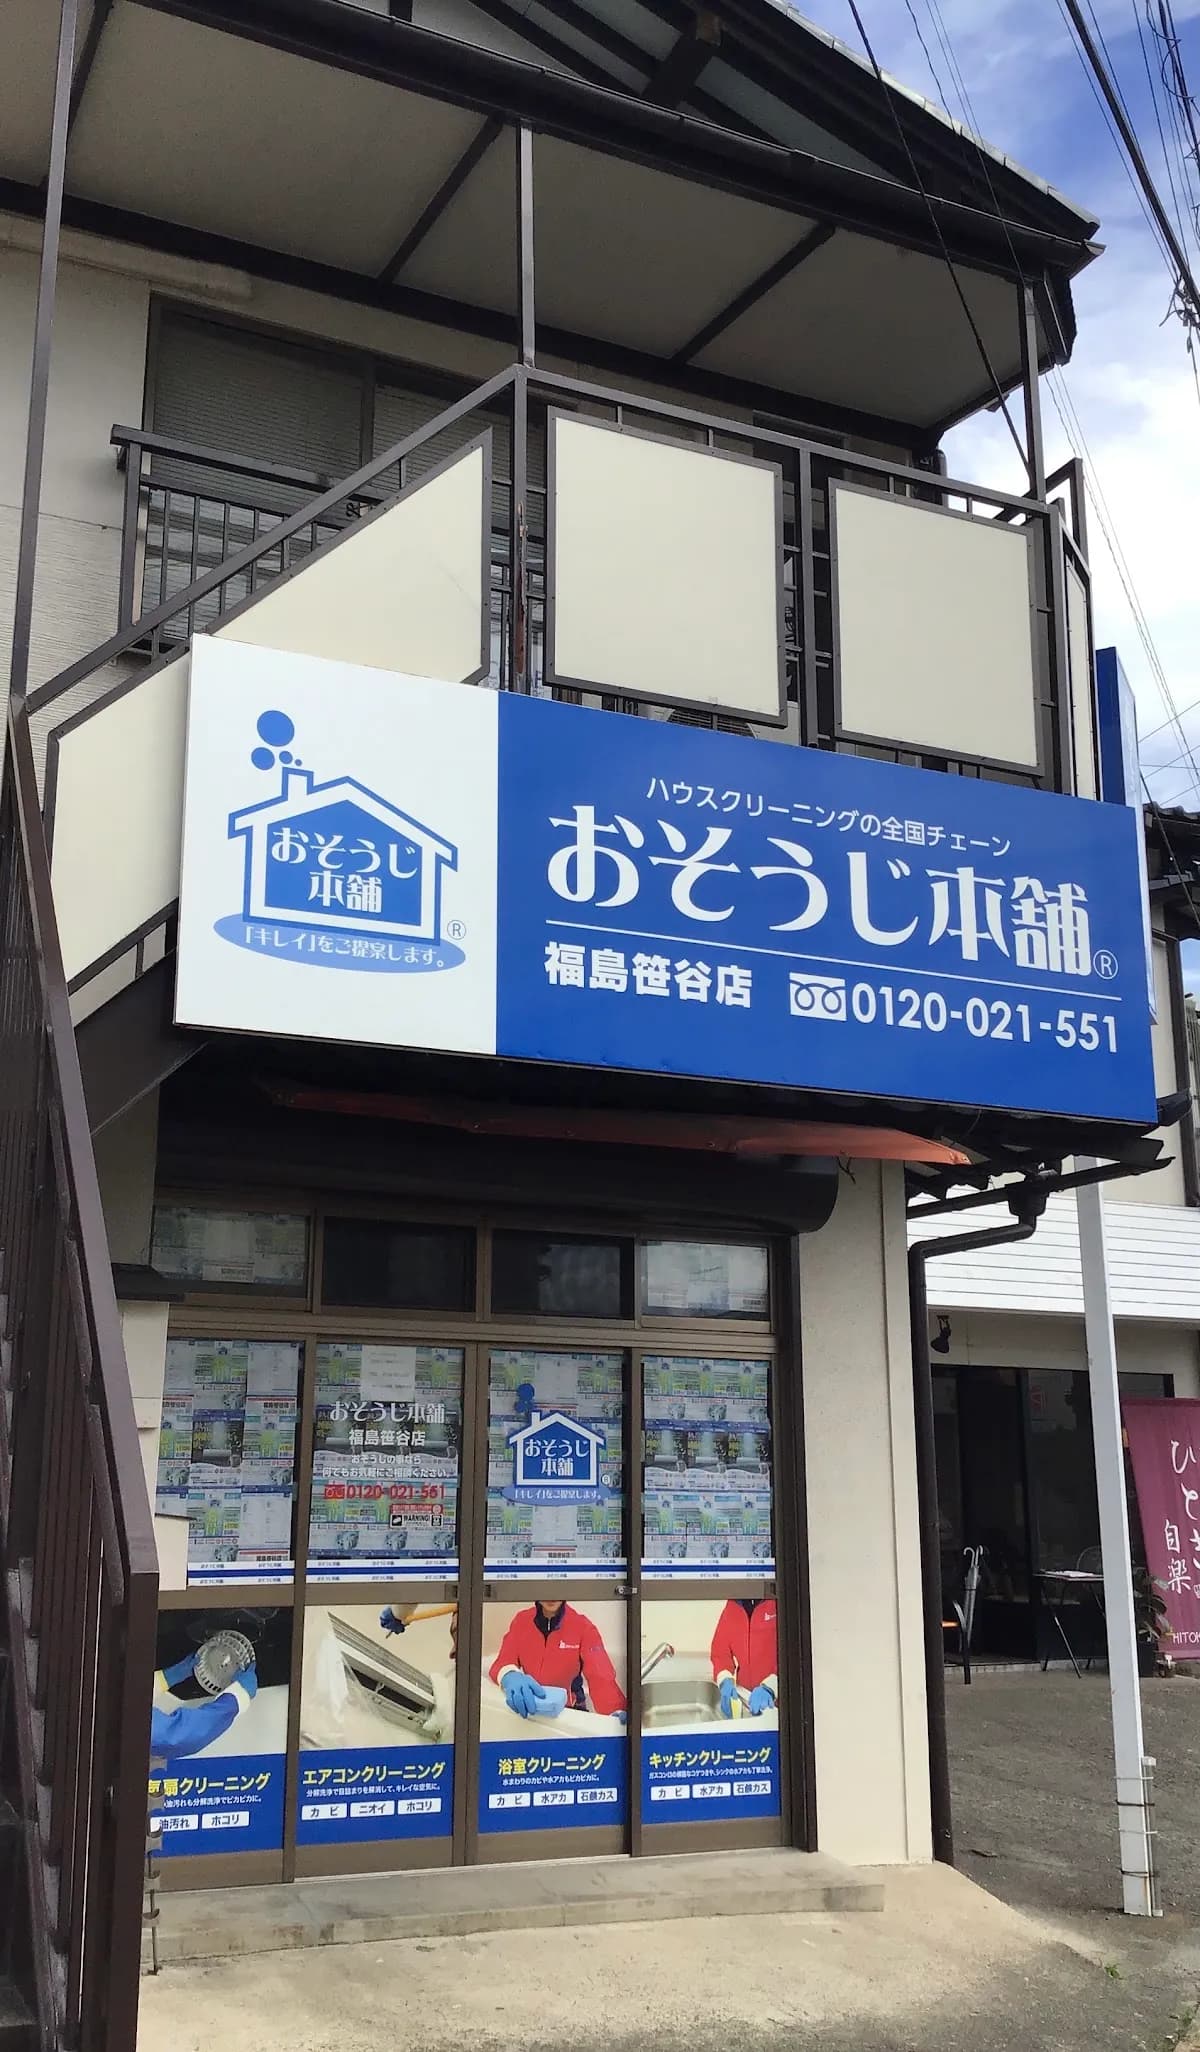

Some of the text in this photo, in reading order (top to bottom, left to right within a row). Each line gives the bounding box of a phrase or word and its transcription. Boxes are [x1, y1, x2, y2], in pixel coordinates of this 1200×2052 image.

[646, 777, 1011, 857] ハウスクリーニングの全国チェーン
[271, 826, 420, 879] おそうじ
[308, 870, 382, 914] 本舗
[547, 805, 1092, 978] おそうじ本舗
[245, 925, 445, 968] 「キレイ」をご提案します。
[544, 941, 753, 1009] 福島笹谷店
[852, 982, 1119, 1054] 0120-021-551
[330, 1400, 445, 1424] おそうじ本舗
[348, 1429, 426, 1447] 福島笹谷店
[525, 1438, 590, 1457] おそうじ
[541, 1458, 574, 1477] 本舗
[498, 1753, 606, 1776] 浴室クリーニング
[648, 1746, 772, 1769] キッチンクリーニング
[302, 1761, 446, 1785] エアコンクリーニング
[541, 1793, 567, 1804] 水アカ
[699, 1785, 724, 1797] 水アカ
[358, 1803, 387, 1814] ニオイ
[406, 1801, 433, 1812] ホコリ
[211, 1813, 240, 1827] ホコリ
